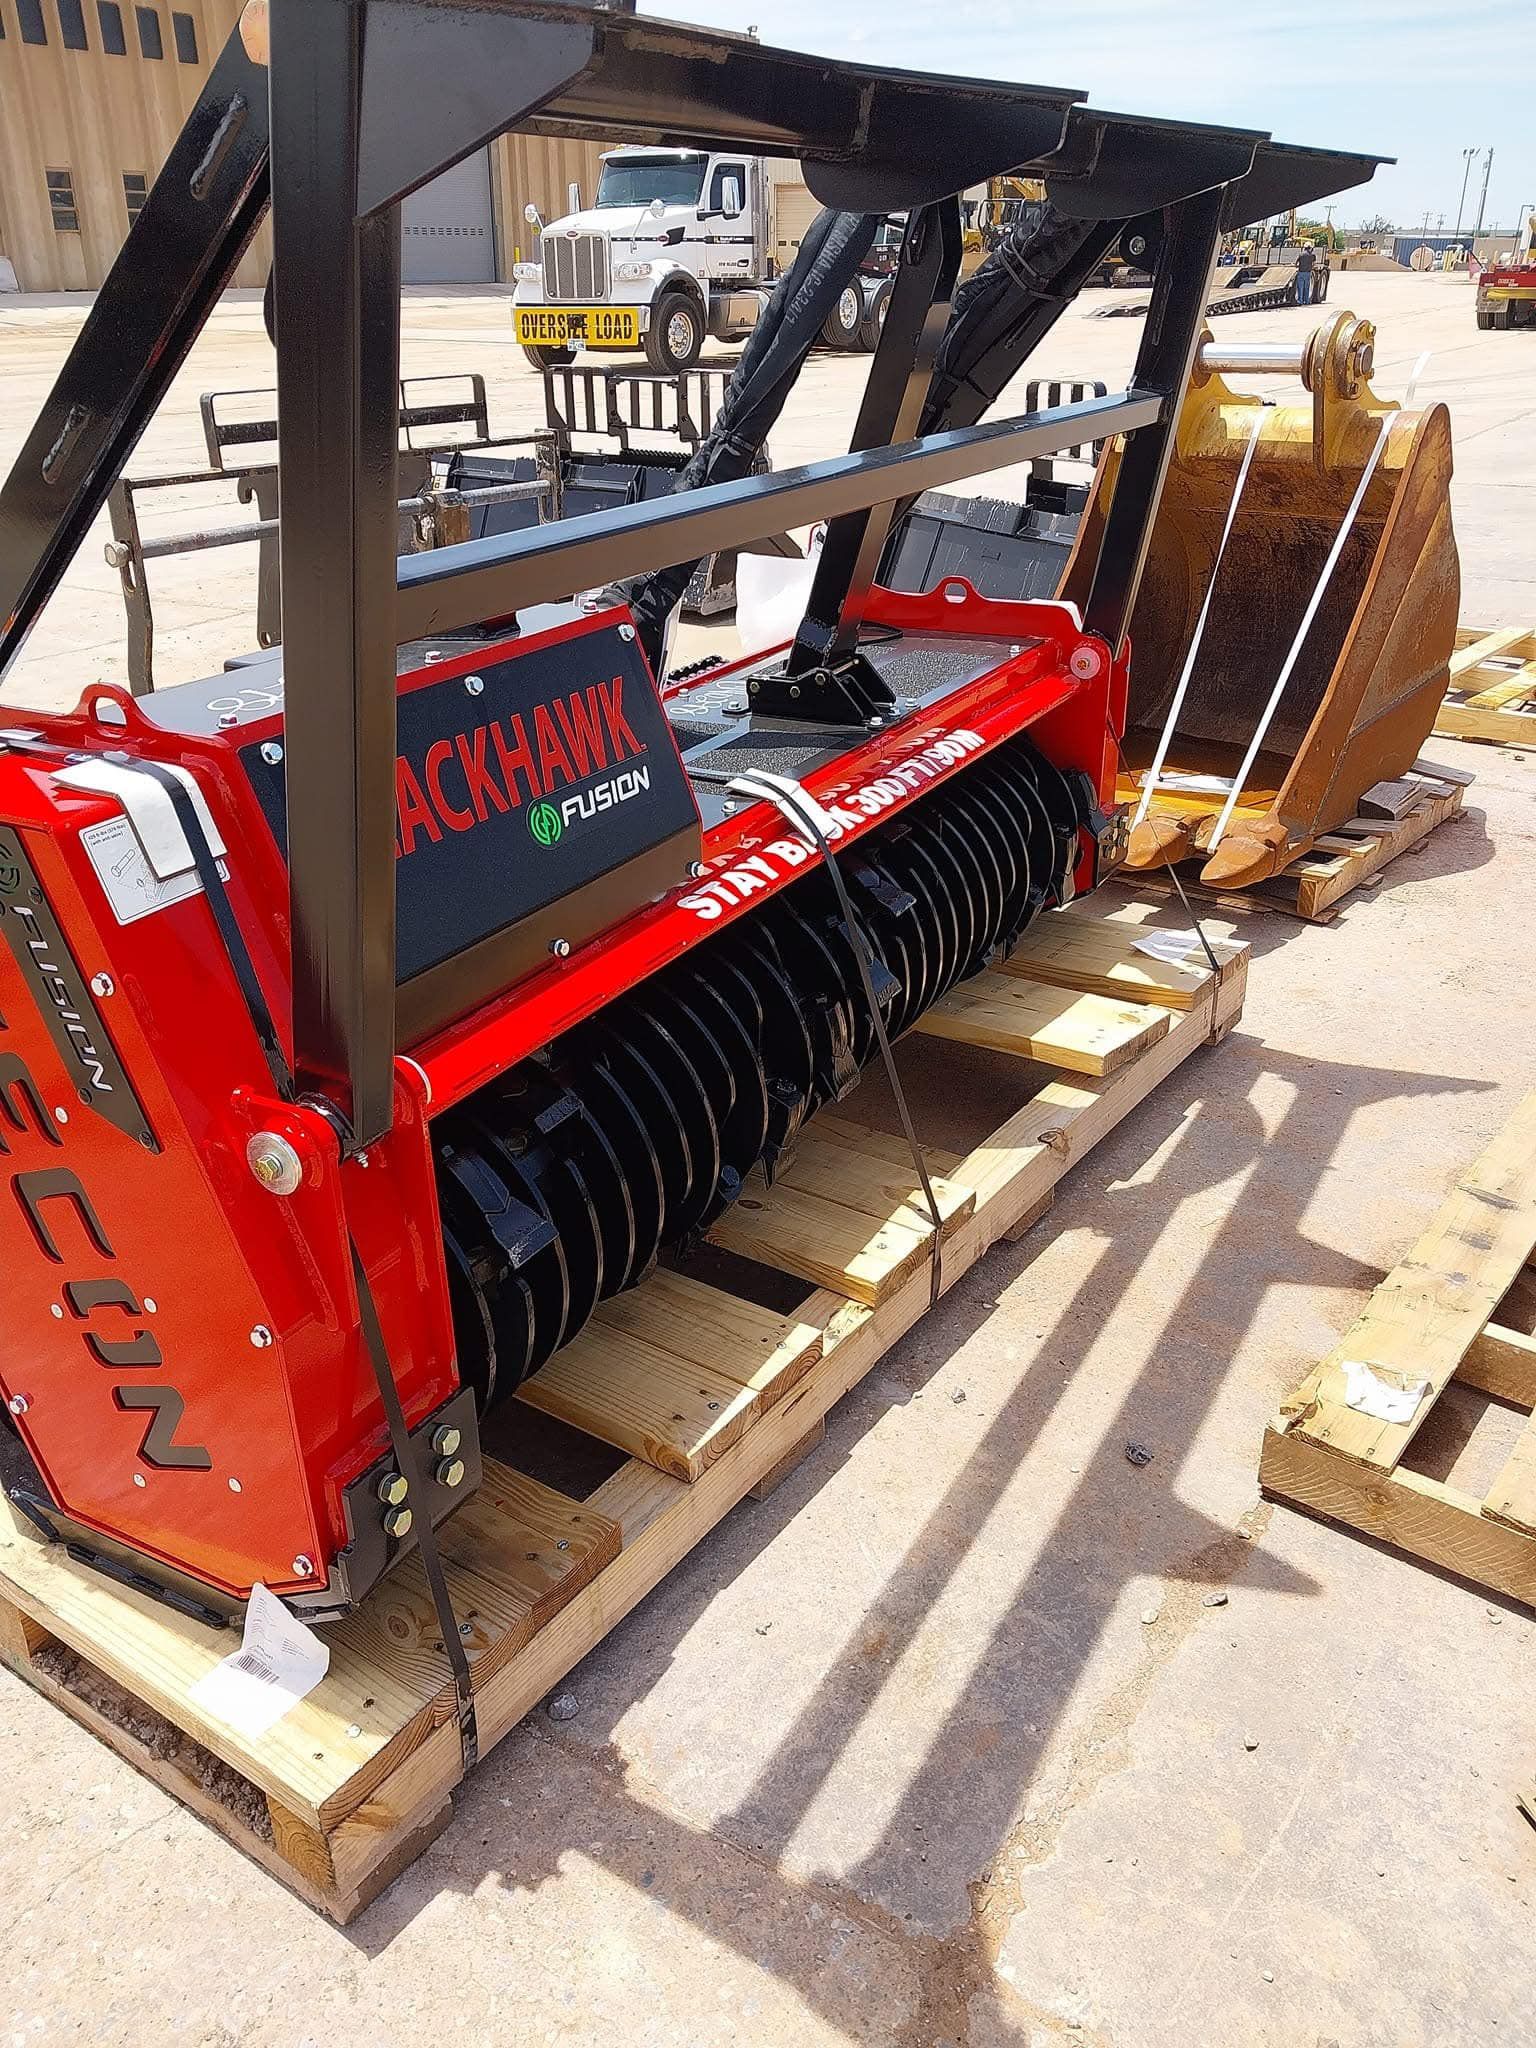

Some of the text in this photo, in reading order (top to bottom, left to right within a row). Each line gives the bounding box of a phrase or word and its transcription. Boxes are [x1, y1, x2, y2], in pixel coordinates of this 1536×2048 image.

[596, 313, 632, 339] LOAD
[395, 675, 643, 859] ACKHAWK
[561, 765, 650, 828] FUSION
[677, 854, 779, 919] STAY
[10, 906, 113, 1092] FUSION
[0, 1010, 212, 1471] ECON
